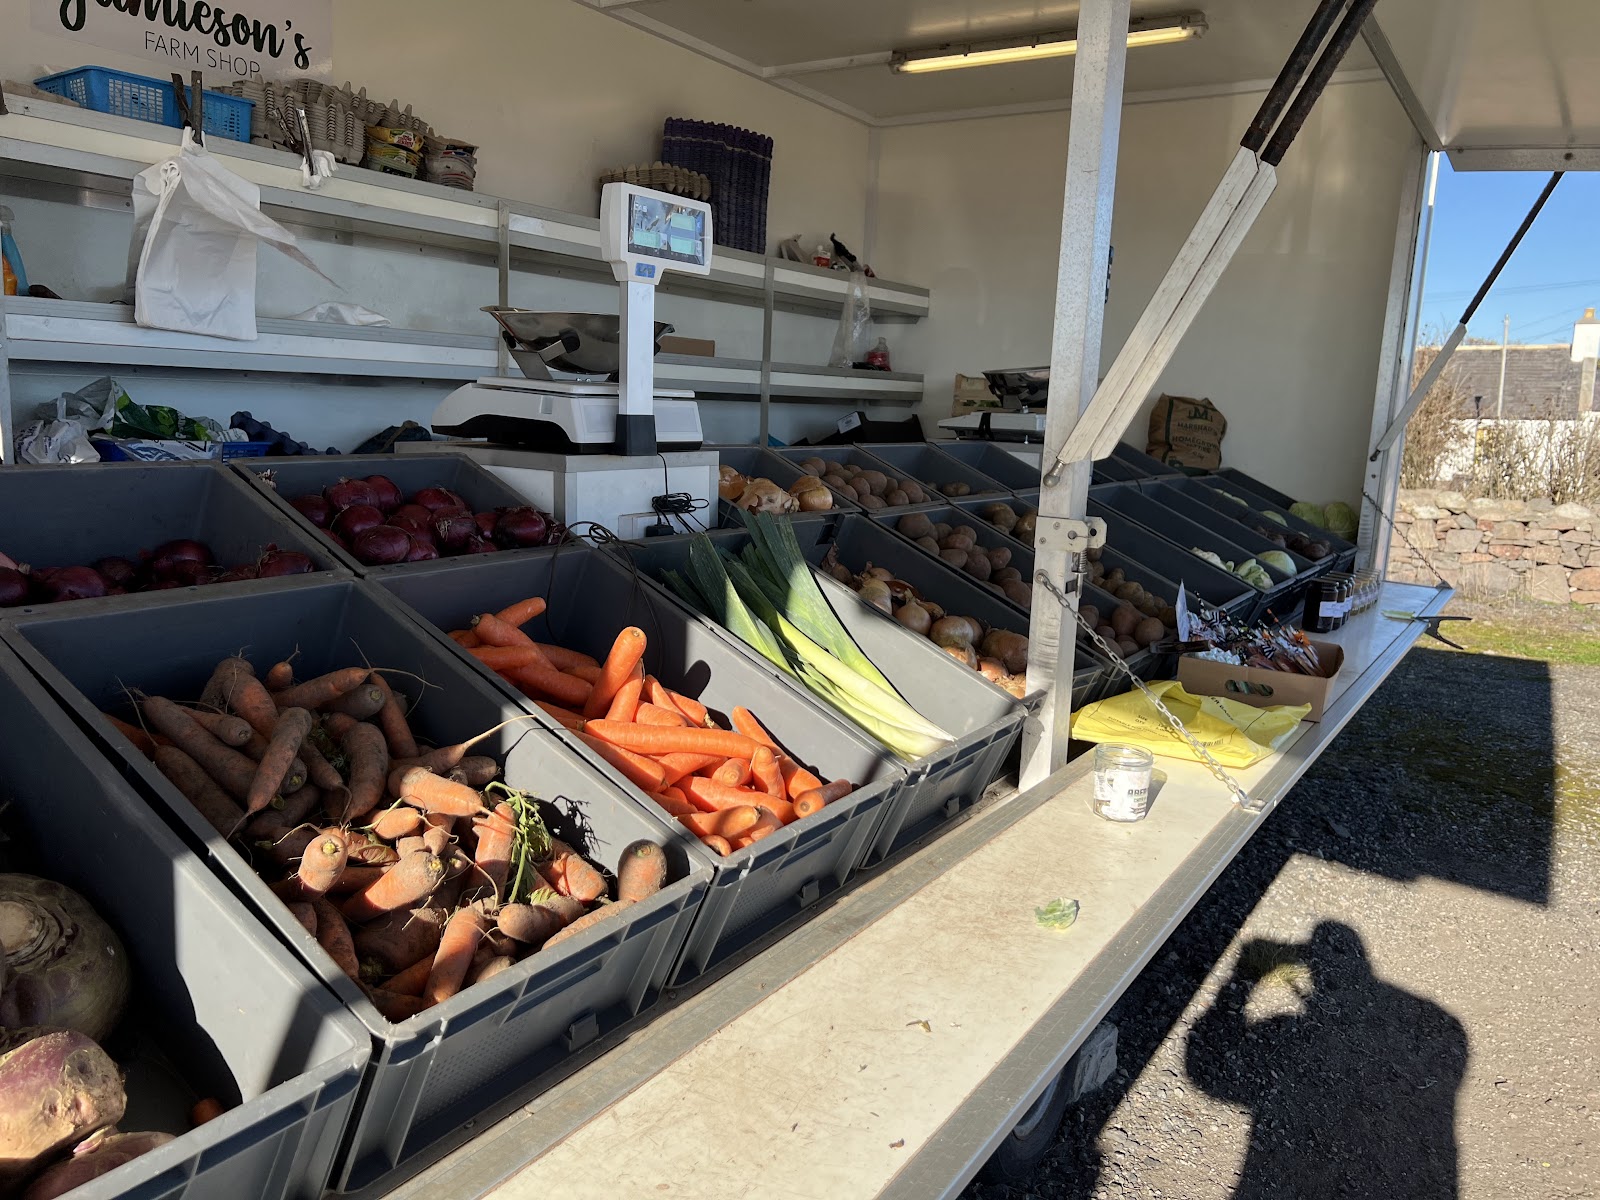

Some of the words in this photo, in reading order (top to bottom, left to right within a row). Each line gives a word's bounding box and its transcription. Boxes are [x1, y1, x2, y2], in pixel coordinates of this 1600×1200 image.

[59, 0, 312, 70] mieson's
[144, 30, 199, 63] FARM
[207, 48, 260, 78] SHOP
